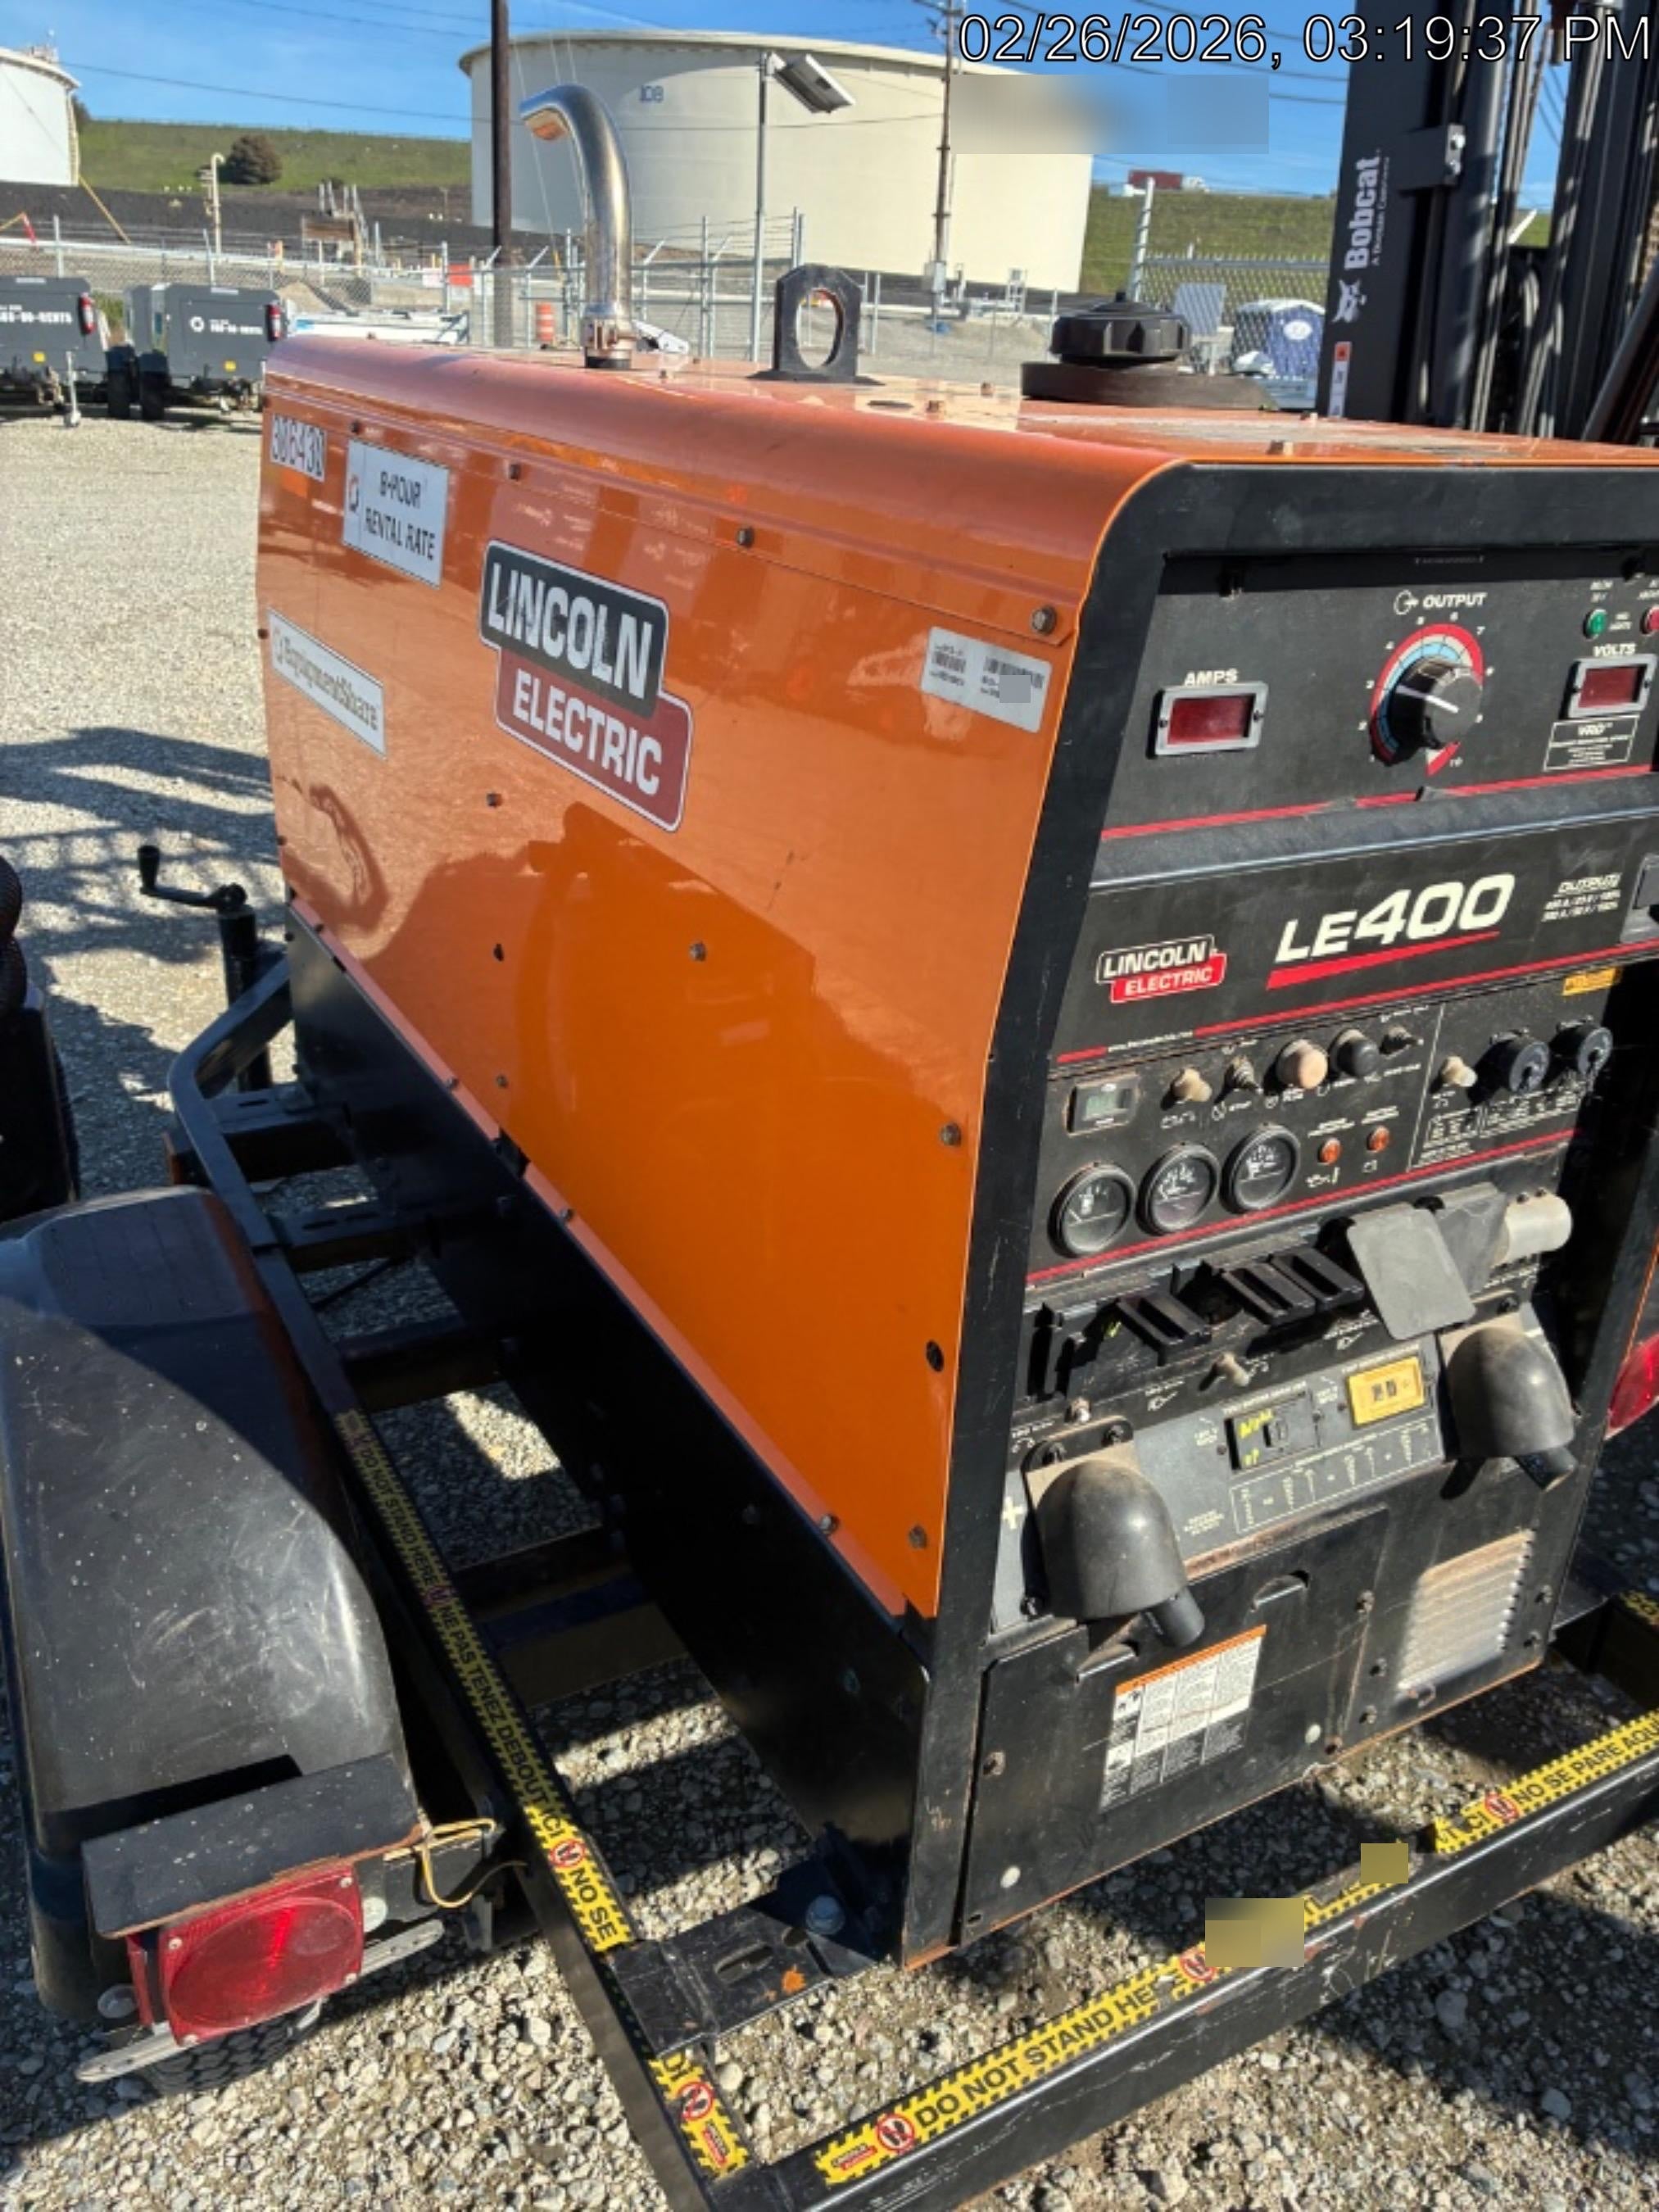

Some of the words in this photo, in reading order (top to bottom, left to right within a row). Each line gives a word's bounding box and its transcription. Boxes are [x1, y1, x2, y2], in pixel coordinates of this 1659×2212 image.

[1344, 156, 1380, 270] Bobcat
[365, 508, 403, 547] RENTAL
[405, 523, 436, 561] RATE
[488, 563, 653, 700] LINCOLN
[1422, 592, 1488, 609] OUTPUT
[1184, 669, 1240, 687] AMPS
[1593, 642, 1637, 658] VOLTS
[513, 669, 663, 796] ELECTRIC
[1275, 873, 1516, 964] LE400
[1103, 941, 1208, 979] LINCOLN
[1124, 966, 1213, 996] ELECTRIC
[452, 1630, 476, 1664] PAS
[465, 1666, 506, 1725] TENEZ
[496, 1725, 550, 1808] DEBOUT
[1510, 1783, 1545, 1806] NO
[1543, 1768, 1575, 1789] SE
[1570, 1742, 1625, 1775] PARE
[1621, 1719, 1659, 1751] AQU
[568, 1868, 598, 1903] NO
[588, 1906, 619, 1941] SE
[913, 2093, 961, 2128] DO
[959, 2056, 1022, 2102] NOT
[1024, 2006, 1115, 2066] STAND
[1113, 1983, 1154, 2017] HE
